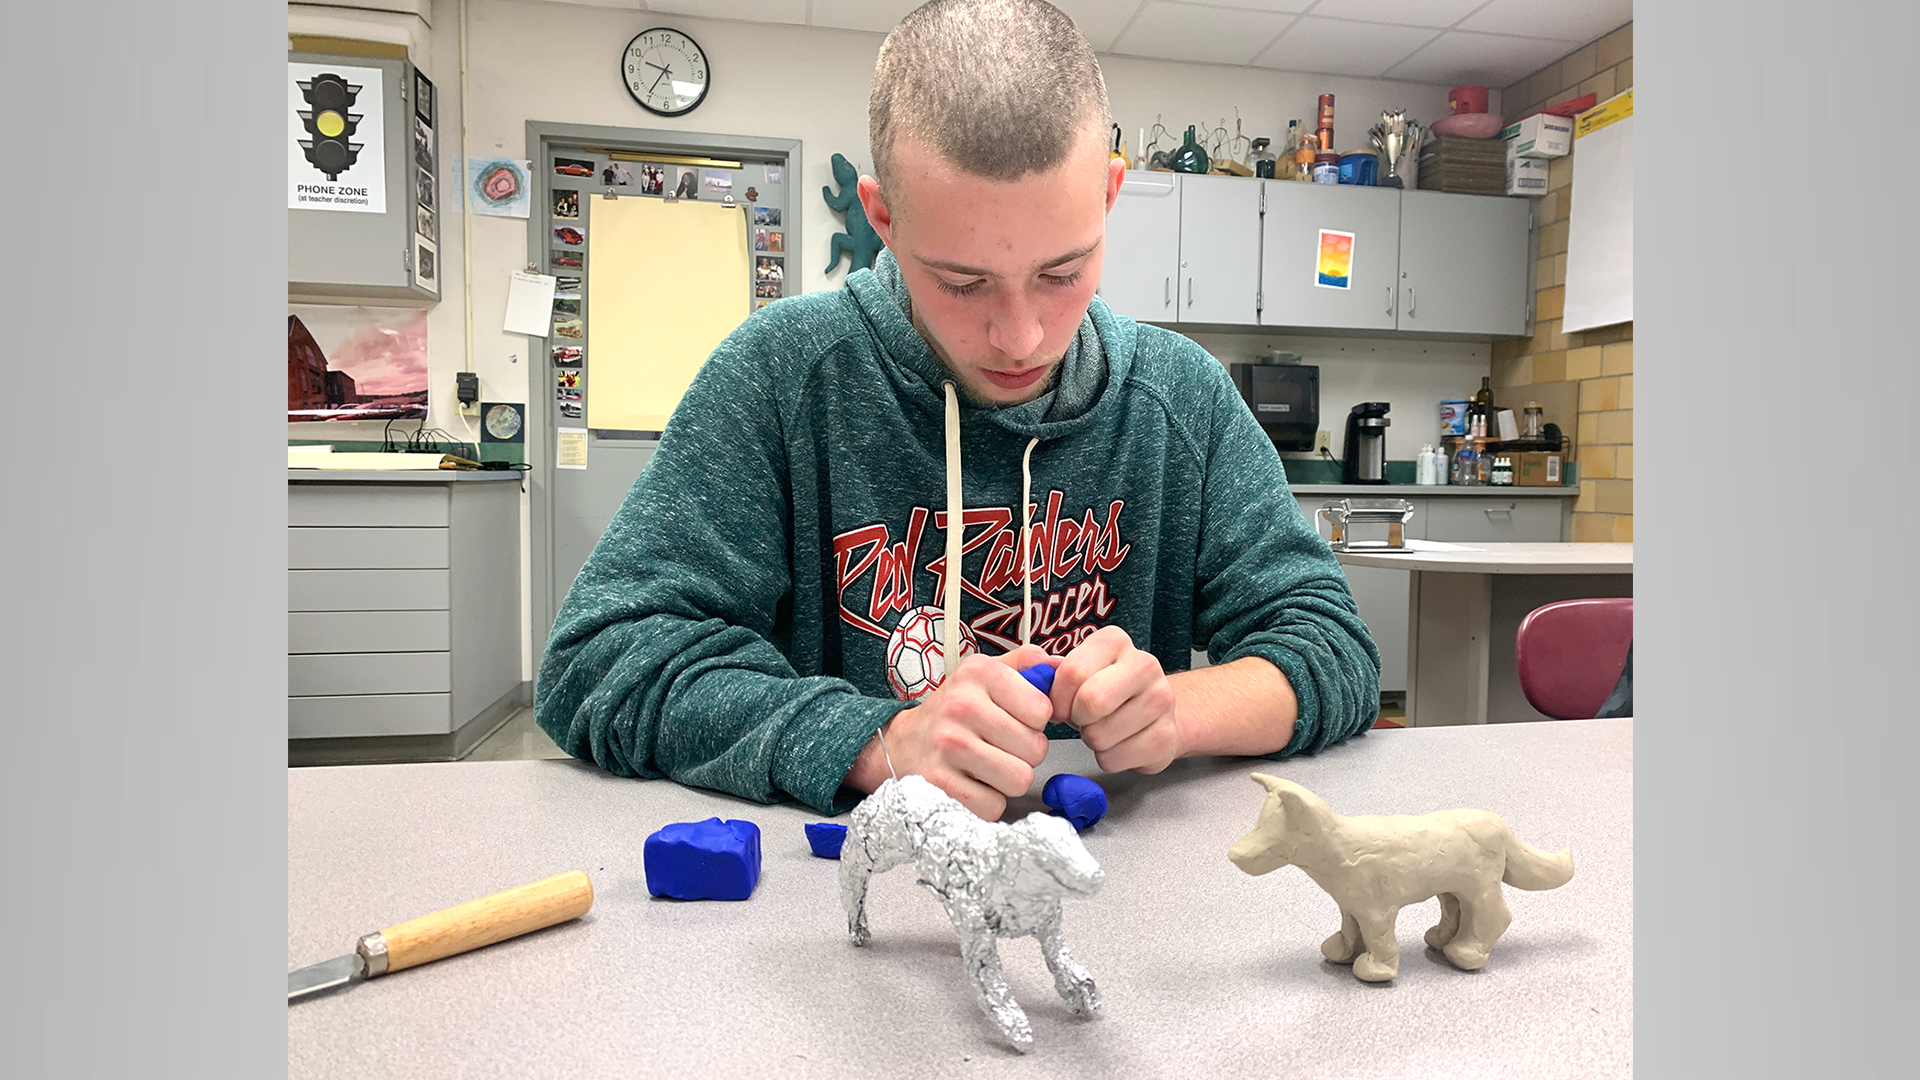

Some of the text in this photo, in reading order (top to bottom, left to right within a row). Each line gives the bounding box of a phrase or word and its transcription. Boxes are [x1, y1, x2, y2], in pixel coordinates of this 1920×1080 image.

[643, 36, 653, 45] 11
[661, 34, 671, 43] 12
[681, 40, 685, 49] 1
[630, 48, 641, 57] 10
[692, 53, 699, 63] 2
[628, 64, 635, 74] 9
[697, 69, 704, 79] 3
[633, 81, 639, 91] 8
[646, 94, 652, 104] 7
[663, 100, 670, 110] 6
[297, 184, 368, 196] PHONE ZONE
[298, 194, 369, 206] (at teacher discretion)
[833, 490, 1130, 638] Red Raiders
[969, 573, 1116, 650] Soccer
